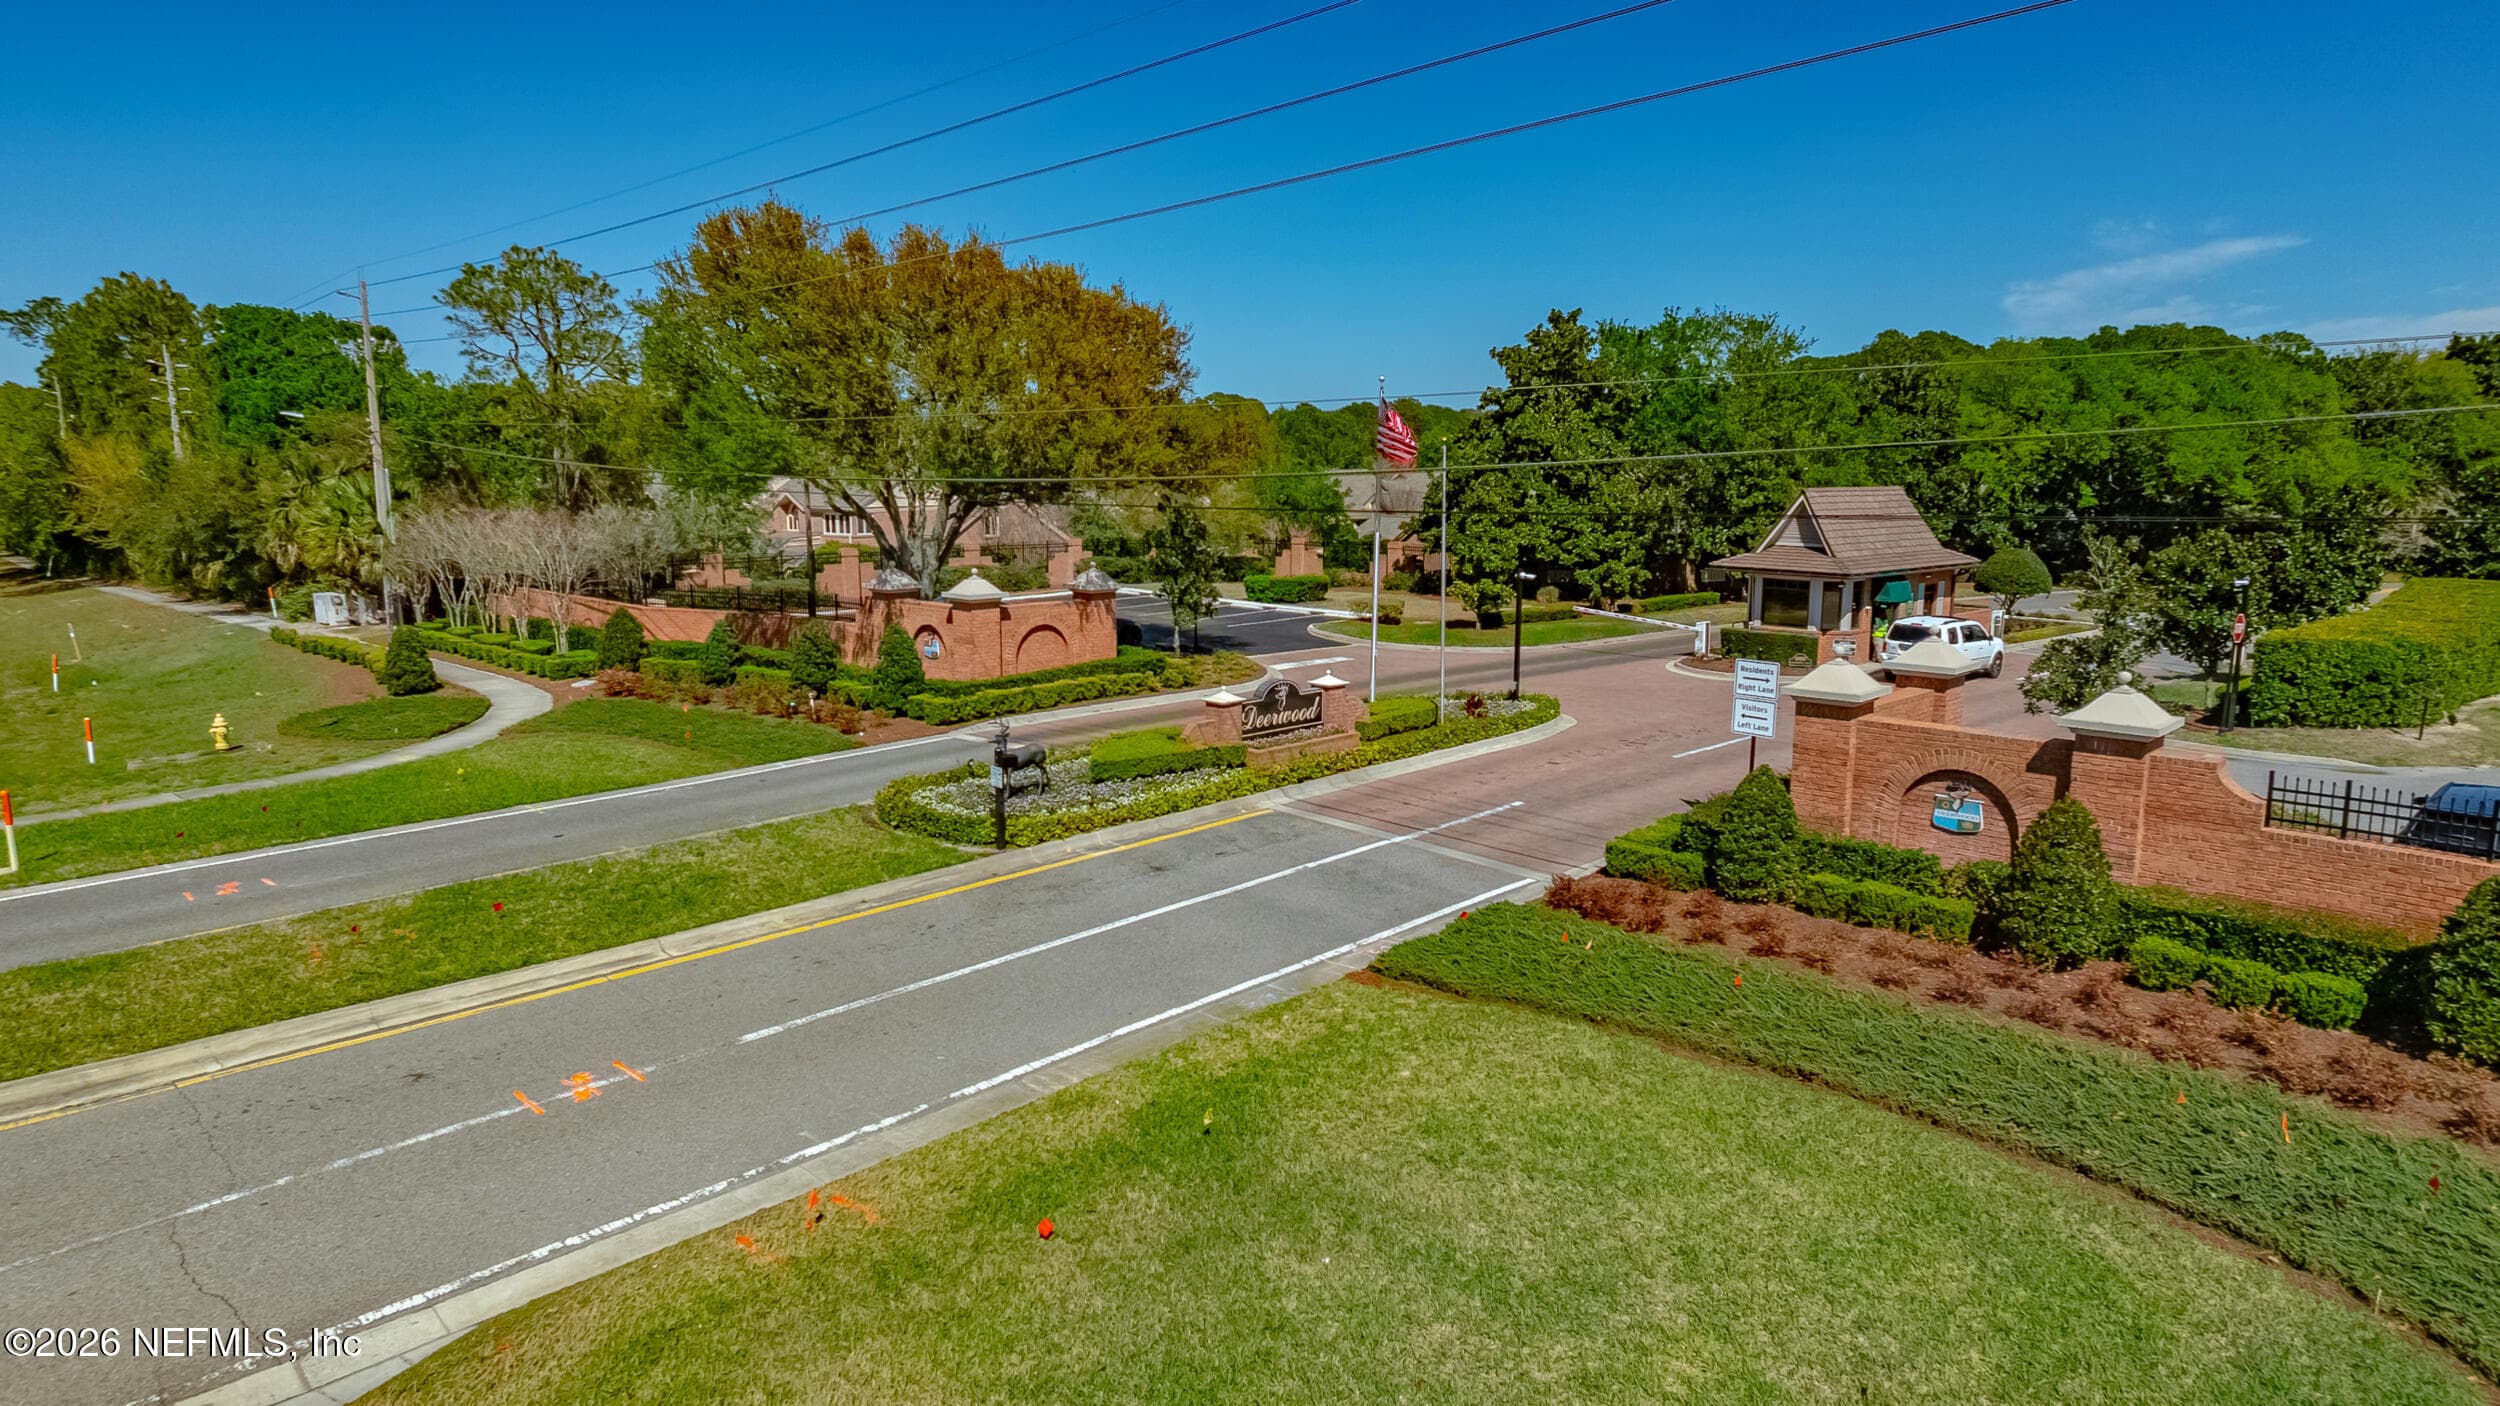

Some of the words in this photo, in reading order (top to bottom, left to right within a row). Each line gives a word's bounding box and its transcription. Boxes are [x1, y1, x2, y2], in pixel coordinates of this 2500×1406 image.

[1740, 665, 1774, 676] Residents
[1738, 683, 1756, 692] Right
[1757, 685, 1775, 694] Lane
[1241, 696, 1321, 731] Deerwood
[1741, 703, 1768, 714] Visitors
[1737, 721, 1752, 730] Left
[1753, 723, 1769, 732] Lane
